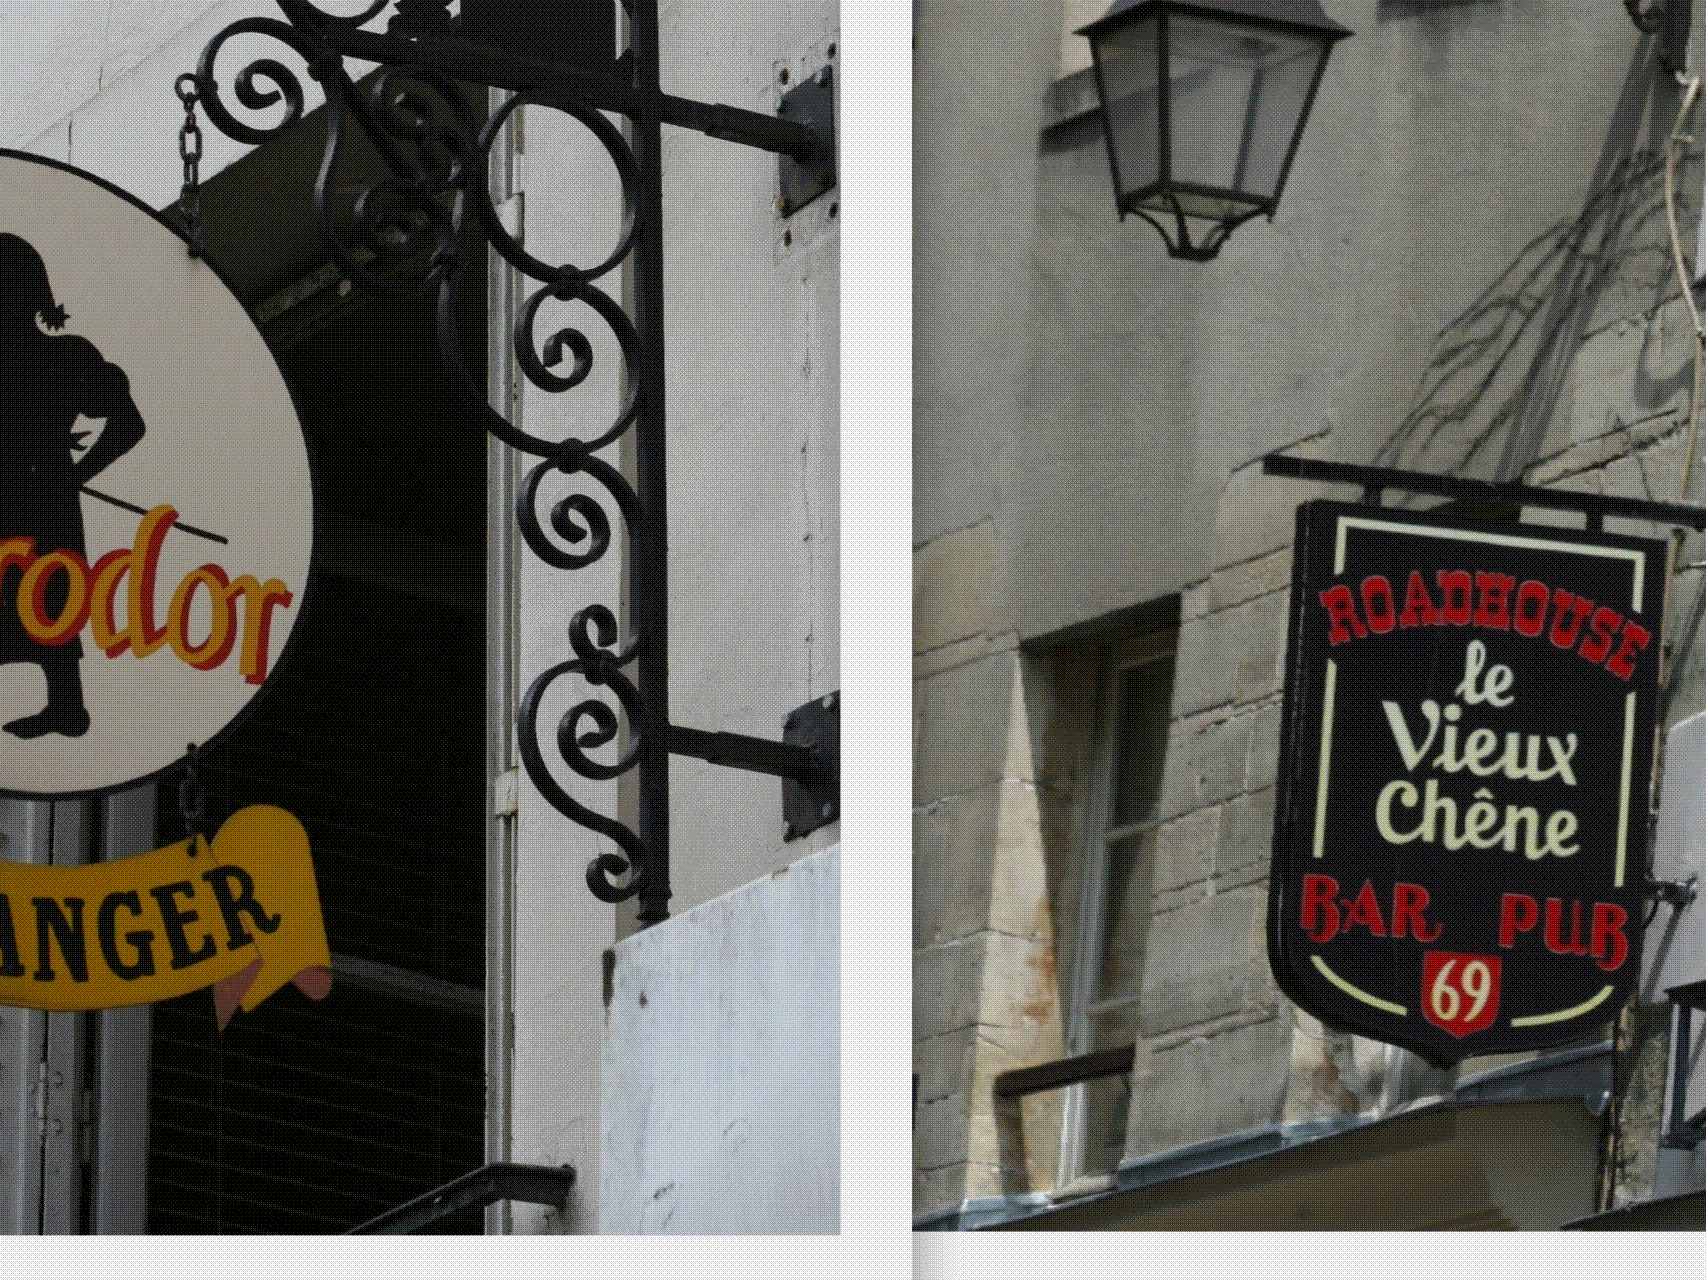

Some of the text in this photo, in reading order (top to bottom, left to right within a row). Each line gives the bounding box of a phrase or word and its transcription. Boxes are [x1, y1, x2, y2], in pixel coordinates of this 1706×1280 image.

[1319, 568, 1652, 682] ROADHOUSE
[1454, 638, 1516, 708] le
[1381, 699, 1579, 786] Vieux
[1375, 779, 1581, 861] Chêne
[1299, 873, 1630, 973] BAR PUB
[1430, 957, 1493, 1024] 69
